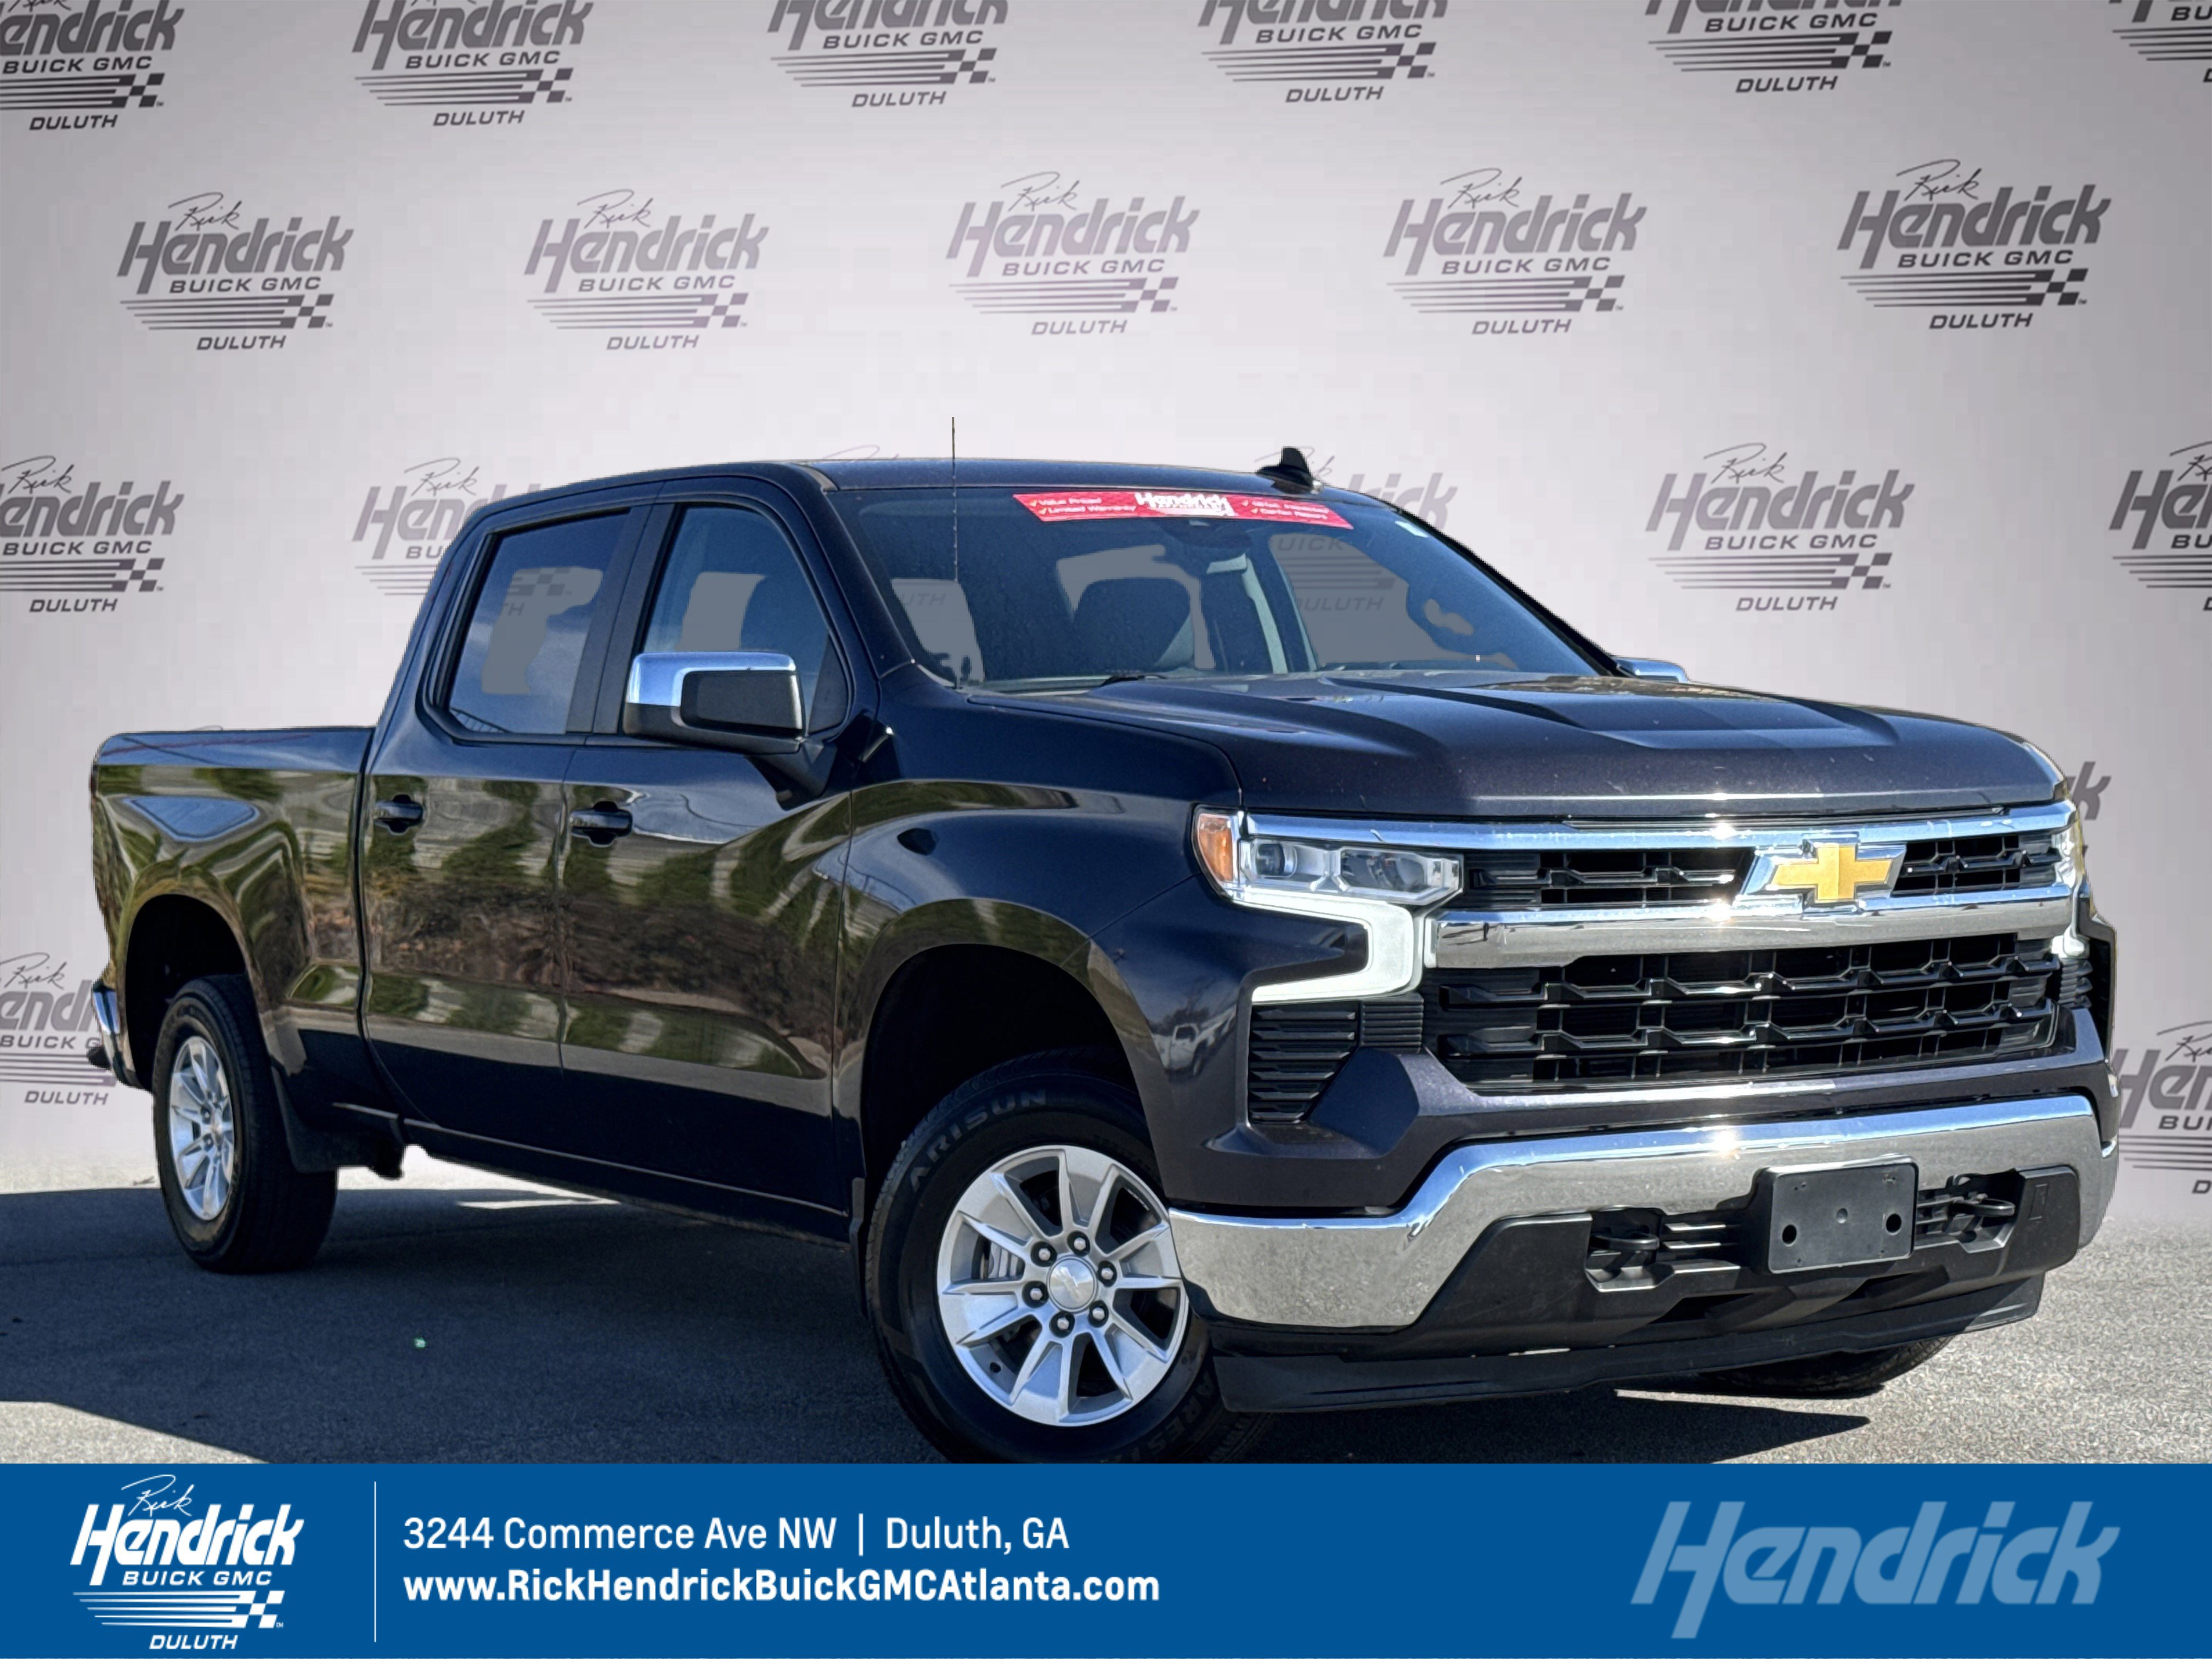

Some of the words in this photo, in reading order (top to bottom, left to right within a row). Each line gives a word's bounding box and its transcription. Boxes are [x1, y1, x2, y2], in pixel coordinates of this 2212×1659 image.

[0, 0, 184, 57] endrick
[1705, 15, 1799, 32] BUICK
[1809, 13, 1877, 29] GMC
[352, 0, 594, 70] Hendrick
[823, 33, 910, 49] BUICK
[920, 30, 983, 46] GMC
[1256, 27, 1346, 43] BUICK
[1357, 24, 1422, 40] GMC
[3, 58, 84, 74] BUICK
[93, 56, 152, 71] GMC
[405, 53, 489, 69] BUICK
[499, 50, 560, 65] GMC
[1736, 76, 1838, 93] DULUTH
[852, 91, 946, 107] DULUTH
[1286, 86, 1384, 103] DULUTH
[30, 115, 118, 130] DULUTH
[433, 110, 524, 126] DULUTH
[1440, 168, 1522, 208] Rick
[1897, 159, 1980, 200] Rick
[1001, 171, 1080, 211] Rick
[168, 192, 242, 230] Rick
[577, 189, 651, 229] Rick
[1384, 193, 1647, 275] Hendrick
[1838, 184, 2112, 269] Hendrick
[946, 196, 1200, 277] Hendrick
[117, 216, 353, 295] Hendrick
[524, 213, 769, 294] Hendrick
[1898, 251, 1993, 268] BUICK
[2004, 250, 2073, 265] GMC
[1002, 261, 1090, 276] BUICK
[1101, 259, 1165, 273] GMC
[1442, 258, 1533, 274] BUICK
[1544, 257, 1610, 272] GMC
[170, 279, 251, 293] BUICK
[261, 276, 321, 291] GMC
[578, 277, 663, 292] BUICK
[674, 275, 735, 290] GMC
[1031, 320, 1127, 335] DULUTH
[1472, 319, 1572, 334] DULUTH
[1929, 313, 2033, 329] DULUTH
[196, 336, 286, 350] DULUTH
[607, 335, 699, 350] DULUTH
[1703, 443, 1786, 484] Rick
[0, 481, 184, 538] endrick
[1646, 468, 1915, 550] Hendrick
[3, 541, 83, 556] BUICK
[93, 541, 151, 554] GMC
[1278, 537, 1344, 551] UICK
[1705, 535, 1798, 550] BUICK
[1810, 534, 1877, 549] GMC
[30, 599, 117, 612] DULUTH
[1736, 596, 1838, 611] DULUTH
[0, 1035, 76, 1049] BUICK
[24, 1091, 108, 1105] DULUTH
[2158, 1115, 2212, 1130] BUI
[910, 1088, 1046, 1193] ARISUN
